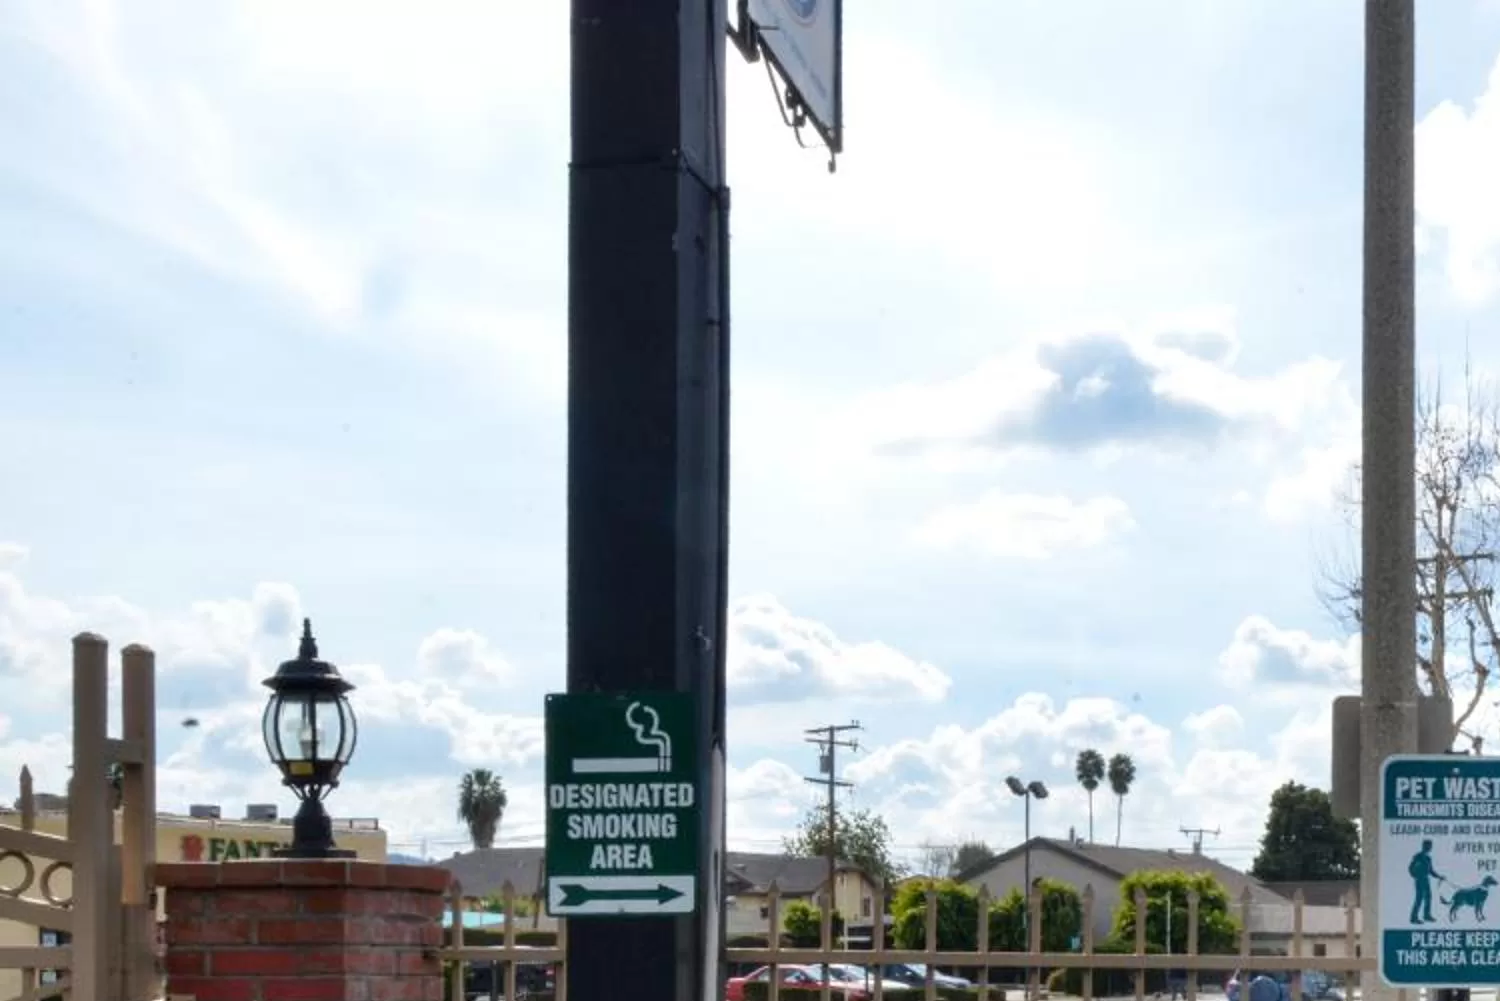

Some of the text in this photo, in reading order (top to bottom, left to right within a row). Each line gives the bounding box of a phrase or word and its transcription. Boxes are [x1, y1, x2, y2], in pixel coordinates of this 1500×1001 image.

[550, 783, 694, 809] DESIGNATED
[1396, 777, 1437, 799] PET
[1397, 803, 1465, 817] TRANSMITS
[567, 813, 677, 839] SMOKING
[1451, 824, 1470, 835] AND
[208, 837, 292, 862] FANT
[1454, 842, 1485, 853] AFTER
[590, 844, 654, 869] AREA
[1477, 859, 1497, 871] PET
[1411, 931, 1500, 948] PLEASE KEEP
[1396, 949, 1428, 965] THIS
[1431, 949, 1467, 965] AREA
